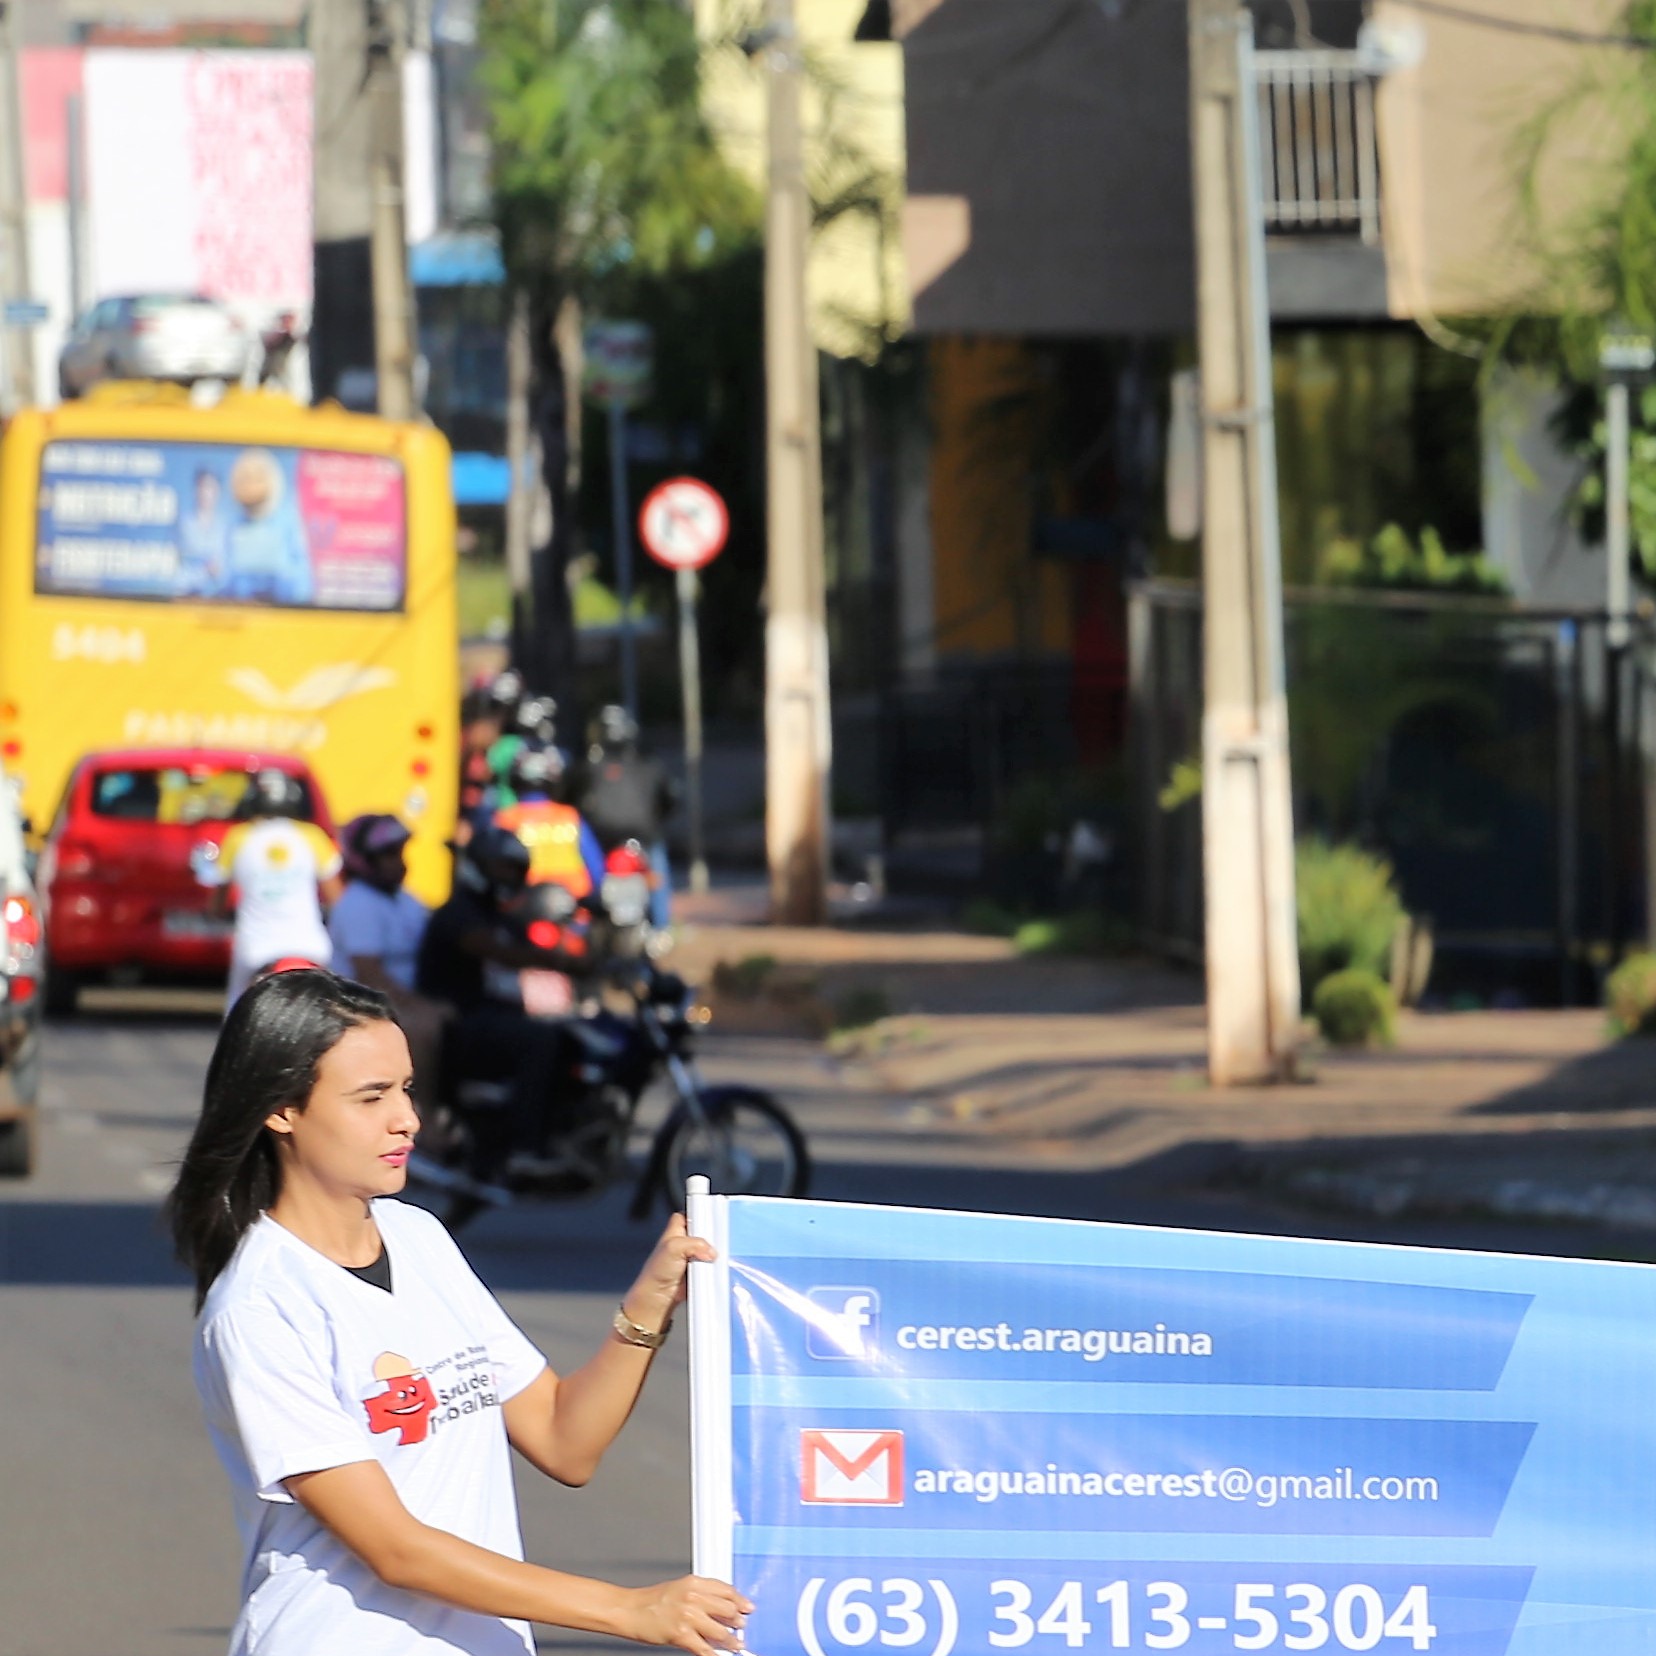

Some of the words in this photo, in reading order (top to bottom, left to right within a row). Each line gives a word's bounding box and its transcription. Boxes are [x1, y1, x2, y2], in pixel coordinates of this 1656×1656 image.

[896, 1323, 1213, 1361] cerest.araguaina
[914, 1464, 1438, 1507] araguainacerest@gmail.com
[987, 1579, 1437, 1651] 3413-5304
